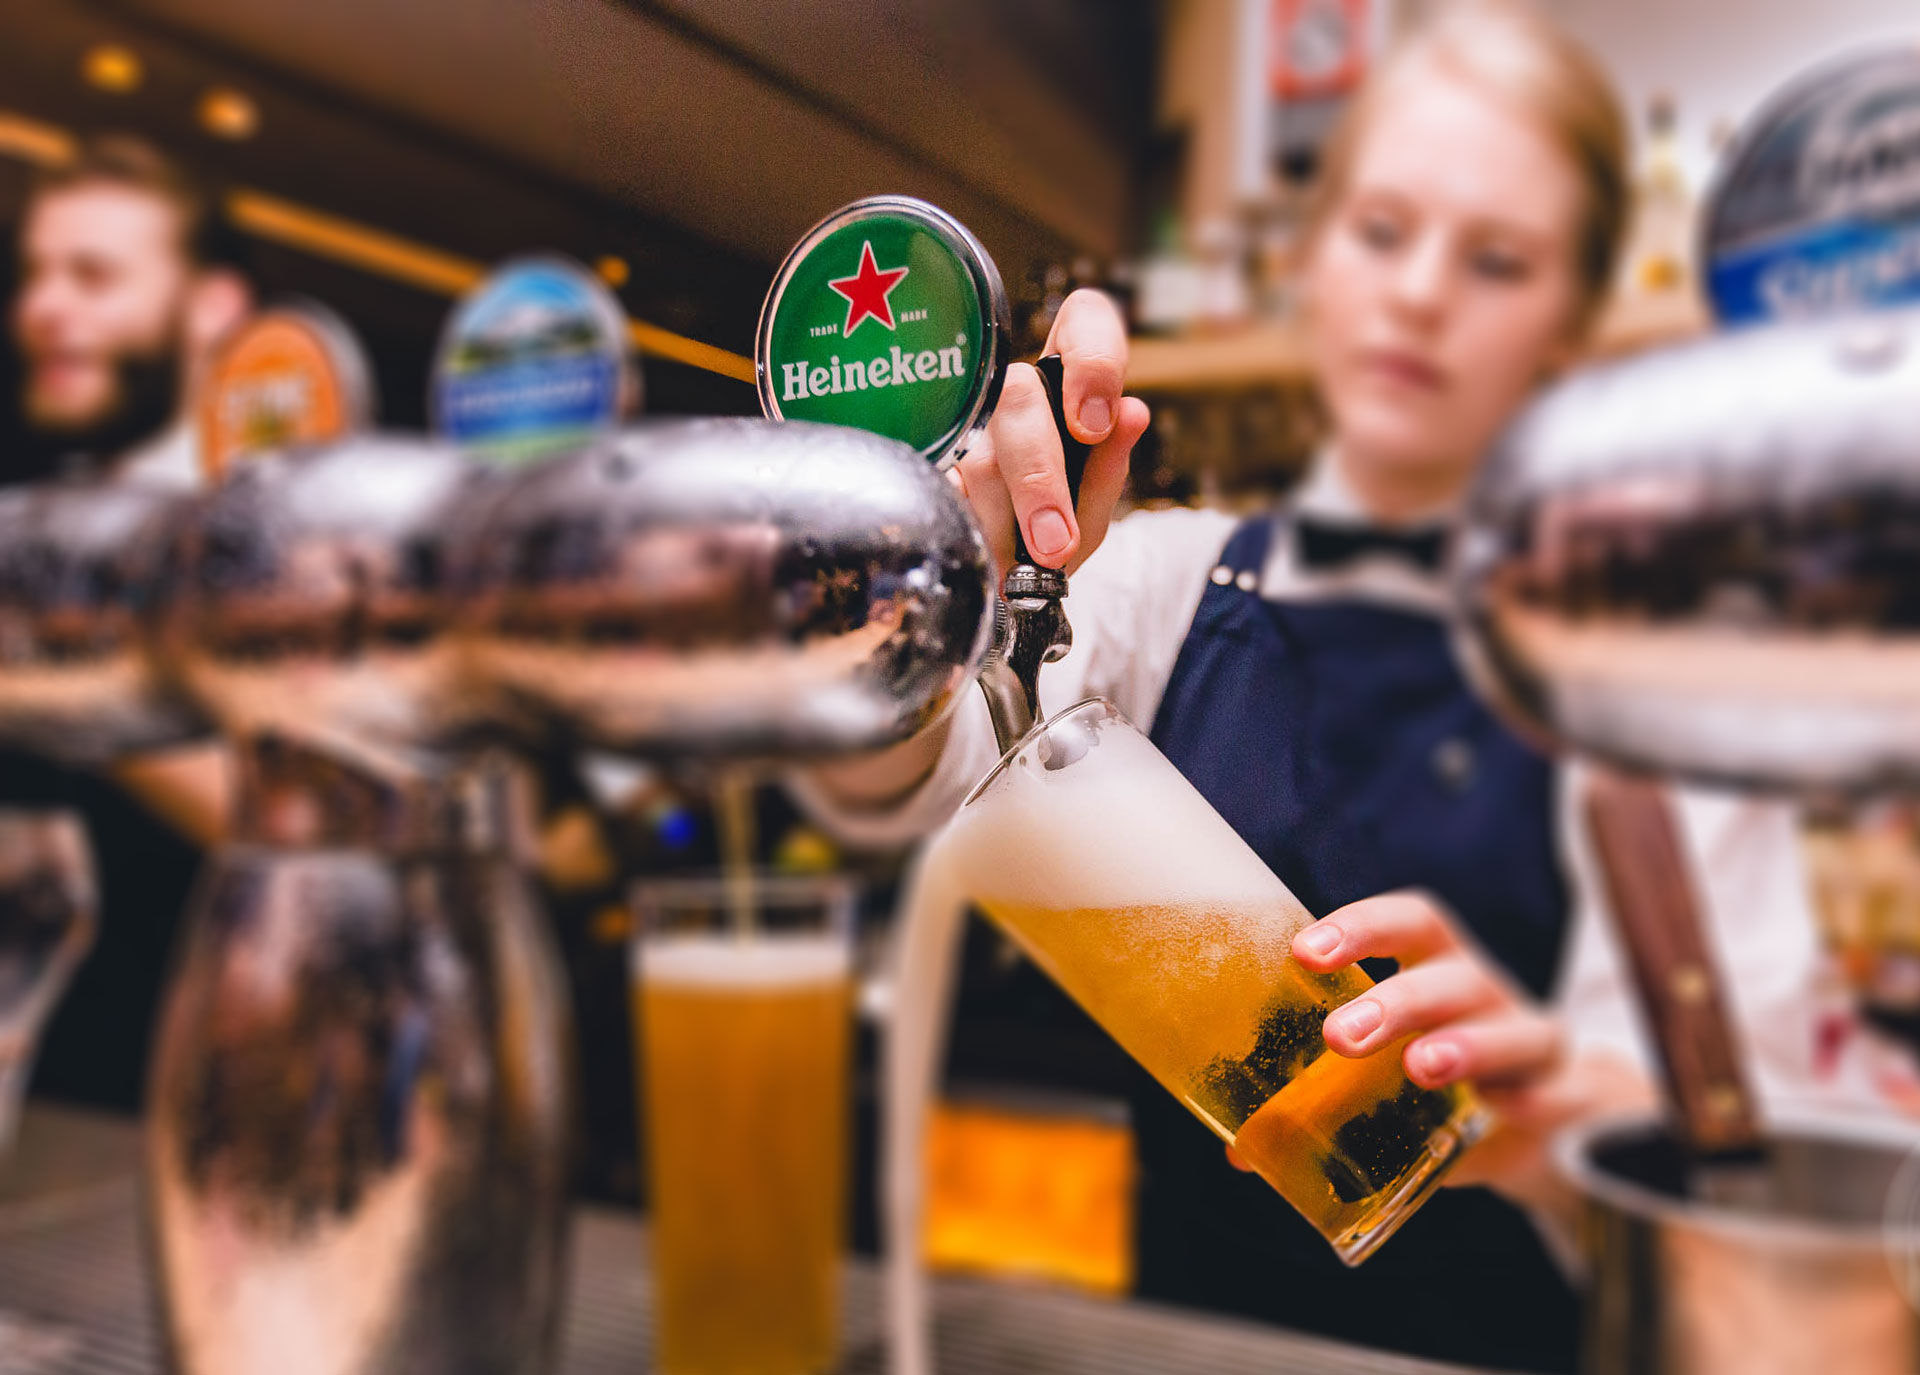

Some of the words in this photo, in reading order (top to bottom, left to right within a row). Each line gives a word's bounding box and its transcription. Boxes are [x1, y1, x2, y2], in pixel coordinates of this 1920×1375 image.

[810, 324, 838, 337] TRADE
[901, 310, 928, 323] MARK
[782, 346, 965, 401] Heineken
